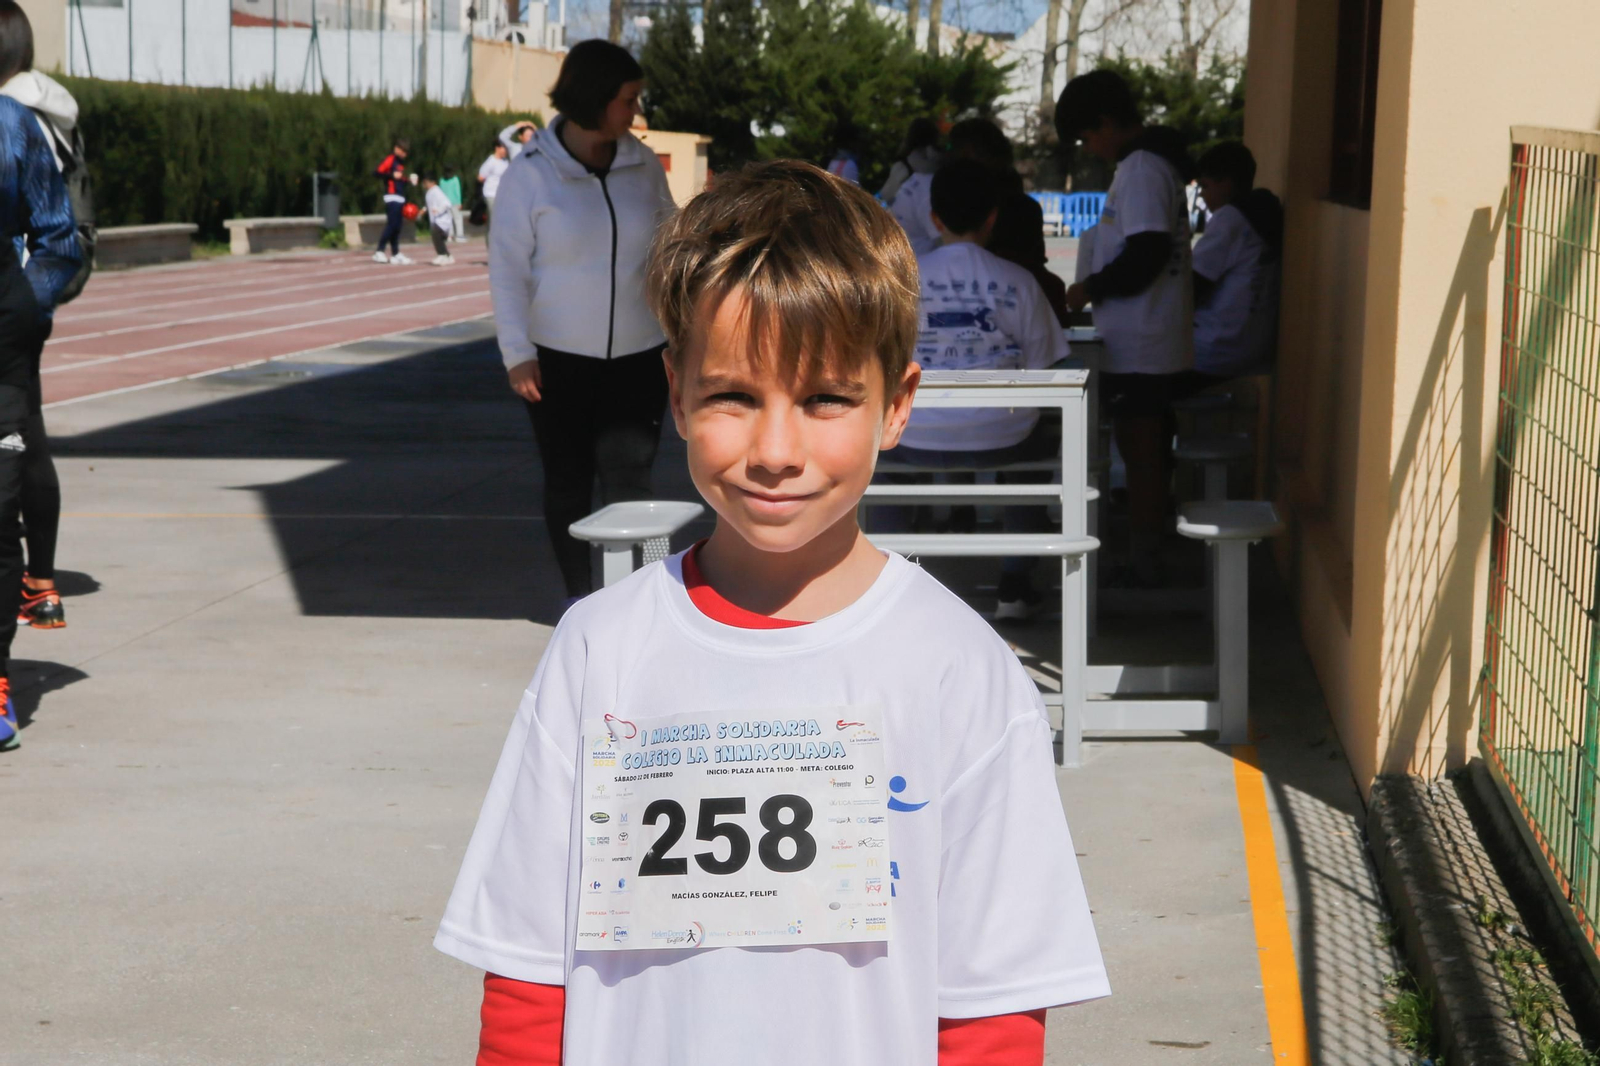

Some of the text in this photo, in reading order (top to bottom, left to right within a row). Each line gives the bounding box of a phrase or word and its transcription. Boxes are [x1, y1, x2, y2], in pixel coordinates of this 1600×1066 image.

[641, 729, 648, 747] I
[650, 722, 711, 745] MARCHA
[686, 745, 709, 764] LA
[592, 759, 616, 767] 2025
[731, 766, 755, 774] PLAZA
[614, 773, 637, 782] SÁBADO
[637, 773, 643, 781] 22
[650, 771, 674, 779] FEBRERO
[638, 794, 817, 876] 258
[671, 891, 701, 899] MACÍAS
[702, 890, 748, 899] GONZÁLEZ,
